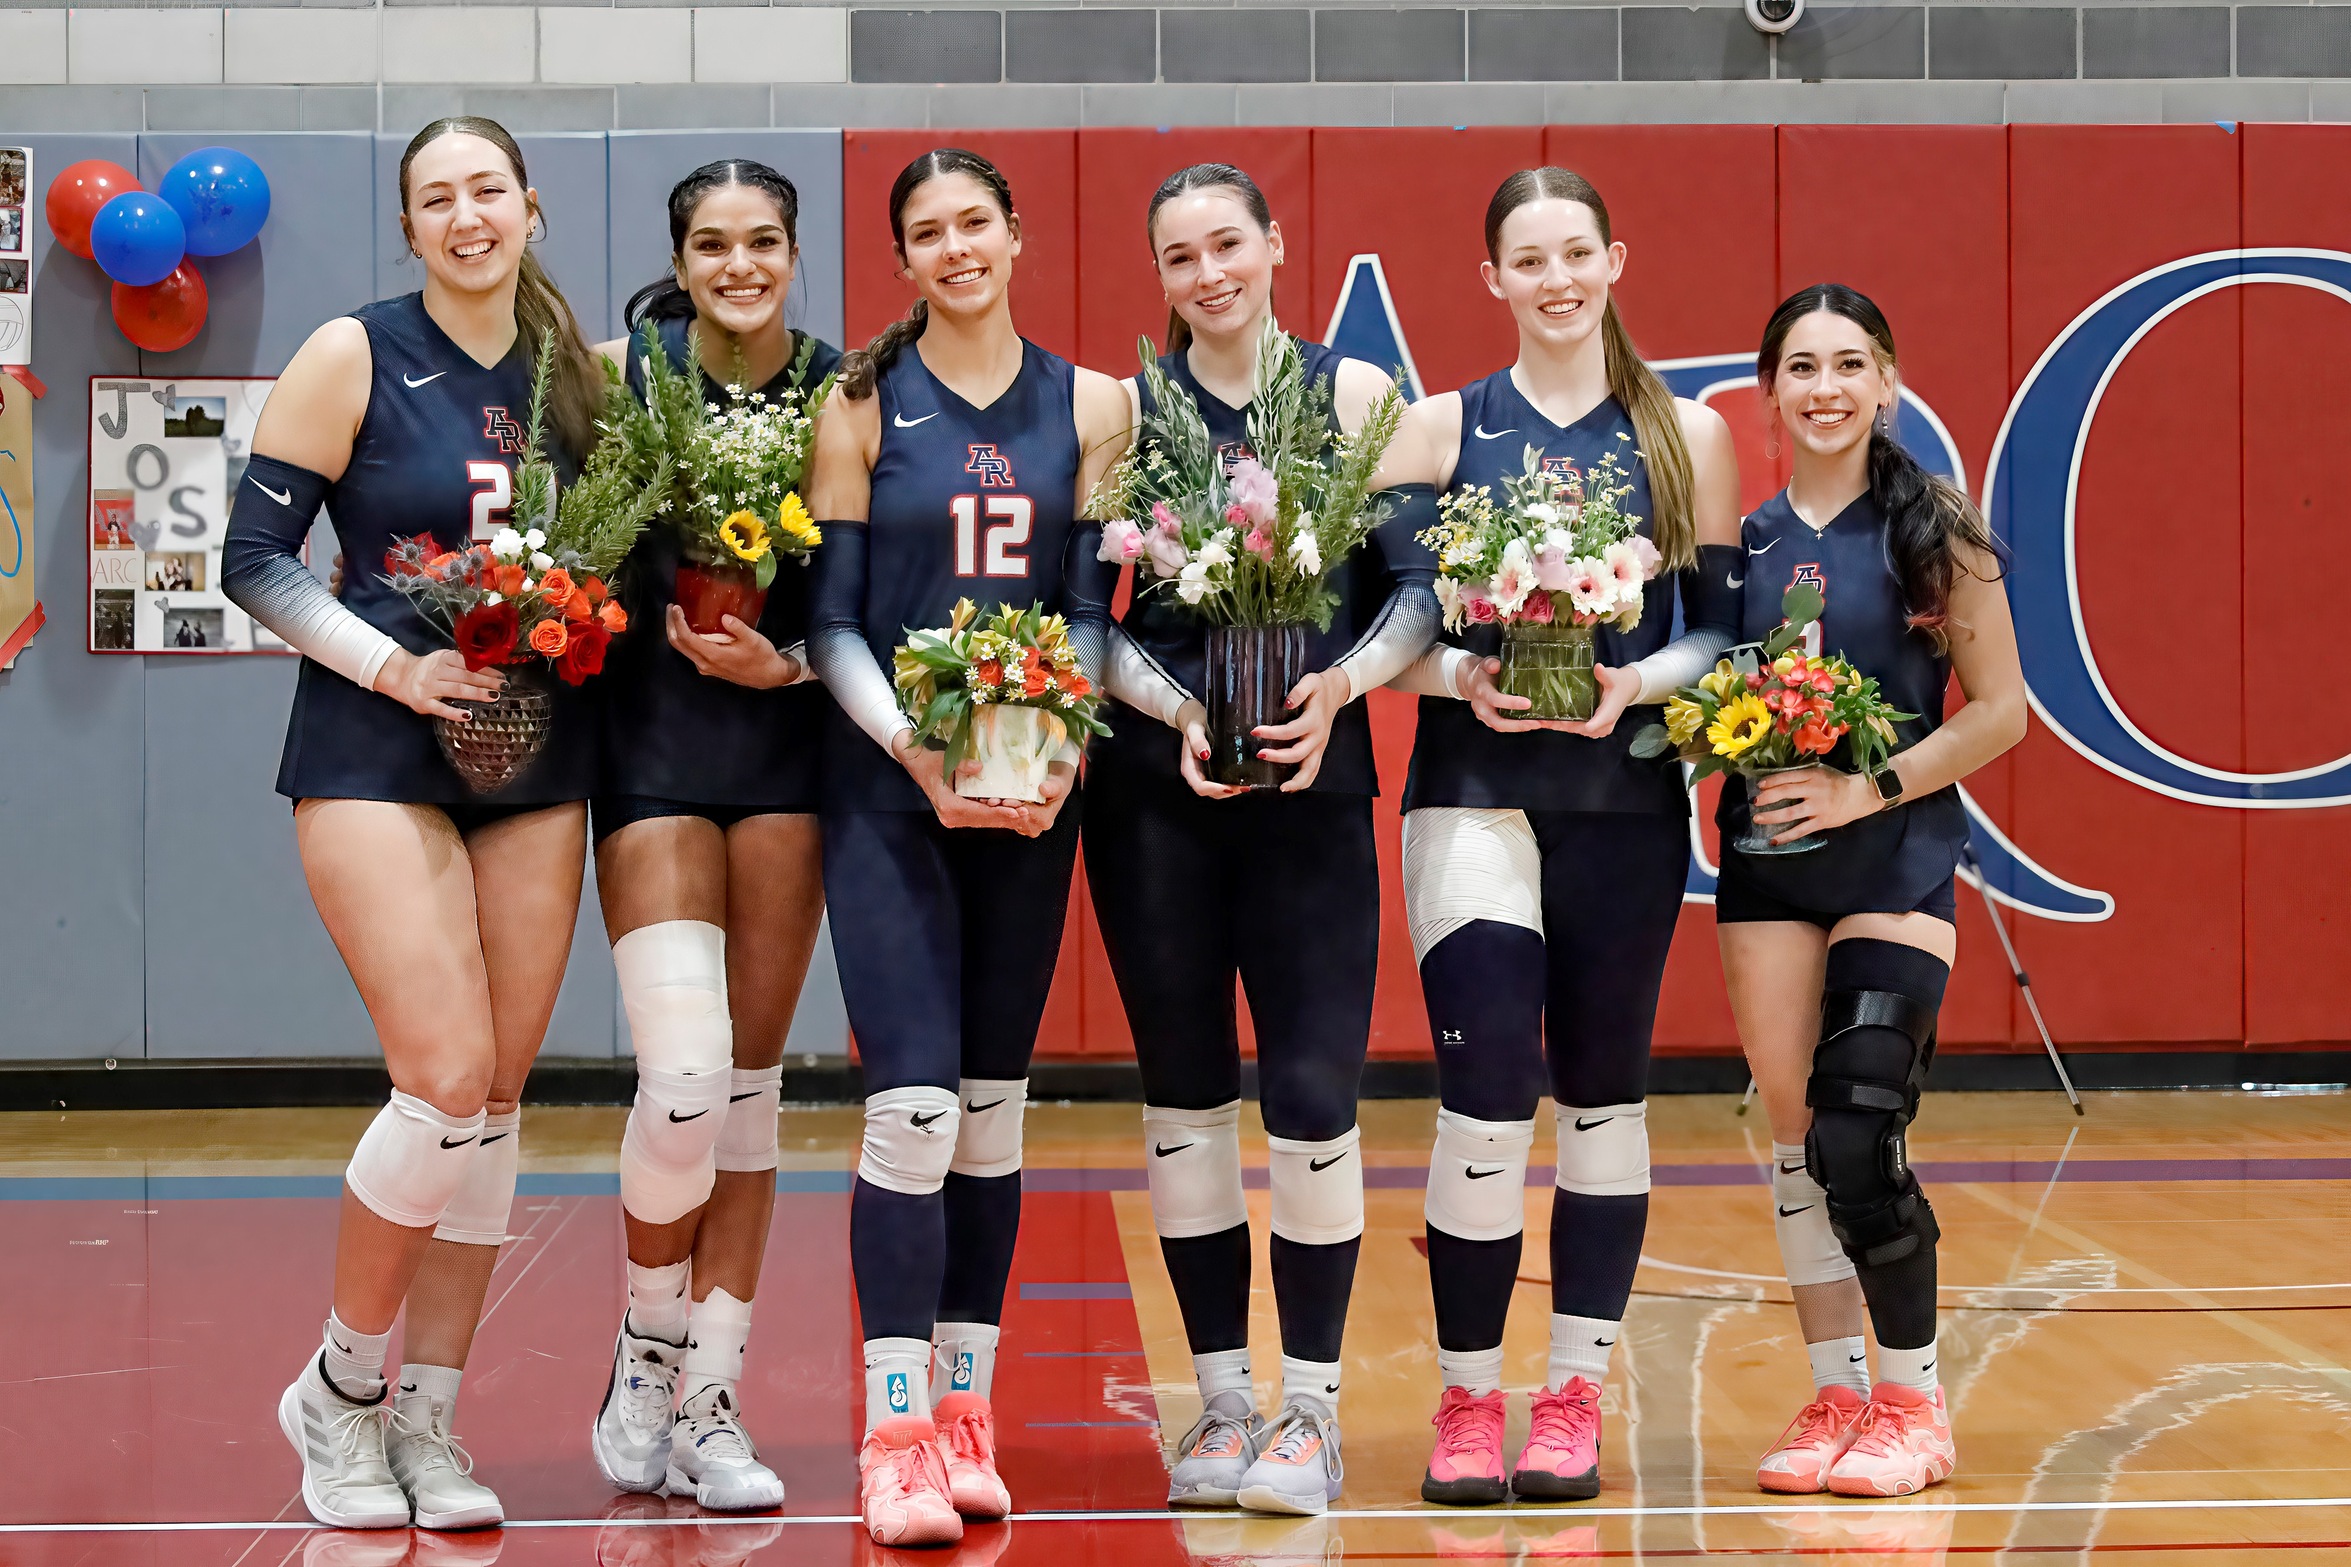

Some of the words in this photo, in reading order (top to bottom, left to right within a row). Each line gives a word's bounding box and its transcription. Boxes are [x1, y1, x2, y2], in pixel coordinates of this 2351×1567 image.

[483, 406, 526, 454] AR
[965, 443, 1016, 487] AR
[466, 460, 559, 543] 2
[949, 493, 1035, 578] 12
[92, 556, 137, 584] ARC
